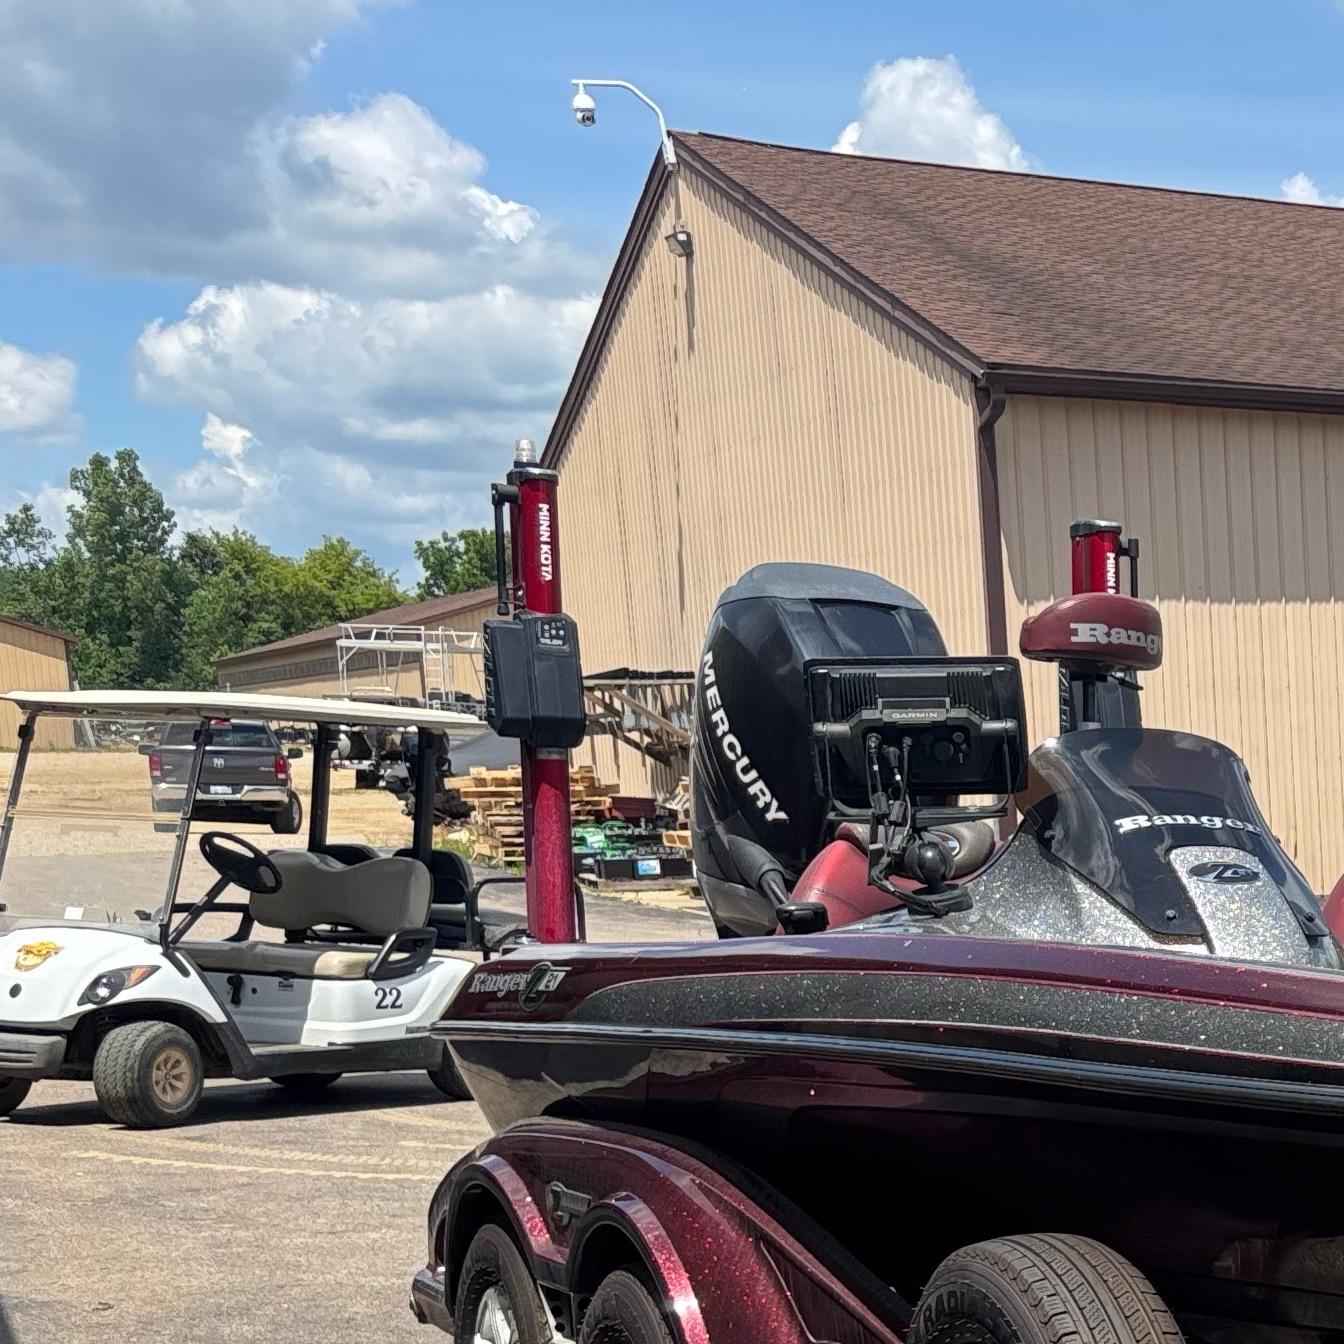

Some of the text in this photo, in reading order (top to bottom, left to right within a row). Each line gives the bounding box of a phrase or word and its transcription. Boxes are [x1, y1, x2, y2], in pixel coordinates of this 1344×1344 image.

[538, 503, 553, 581] MINN KOTA
[1106, 552, 1117, 587] MINN
[1069, 622, 1162, 656] Rang
[891, 711, 938, 719] GARMIN
[702, 651, 790, 824] MERCURY
[1114, 814, 1261, 836] Ranger
[374, 986, 403, 1010] 22
[468, 971, 532, 998] Ranger
